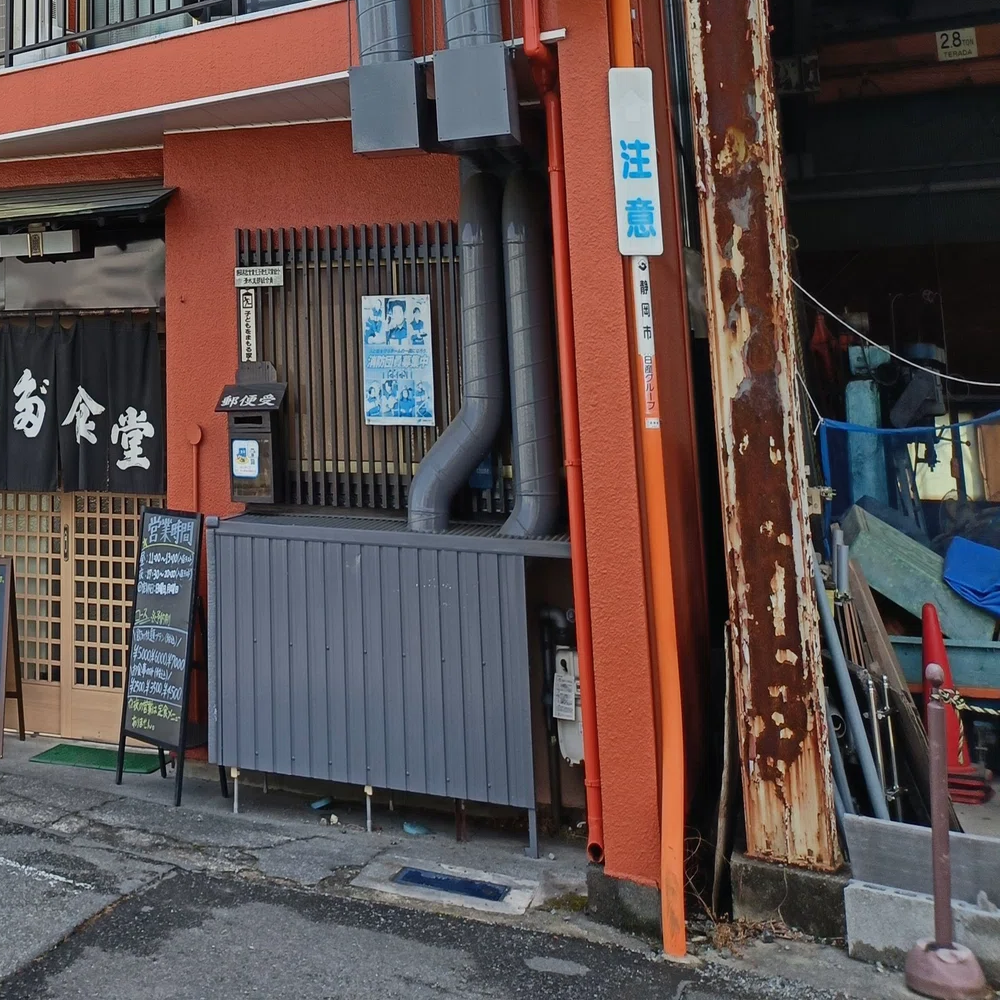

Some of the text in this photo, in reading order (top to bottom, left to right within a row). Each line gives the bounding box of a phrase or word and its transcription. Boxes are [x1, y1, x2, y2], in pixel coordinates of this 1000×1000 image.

[943, 49, 973, 58] TERADA
[619, 139, 657, 239] 注意
[639, 280, 652, 340] 静岡市
[220, 393, 276, 408] 郵便受
[147, 515, 195, 546] 営業時間
